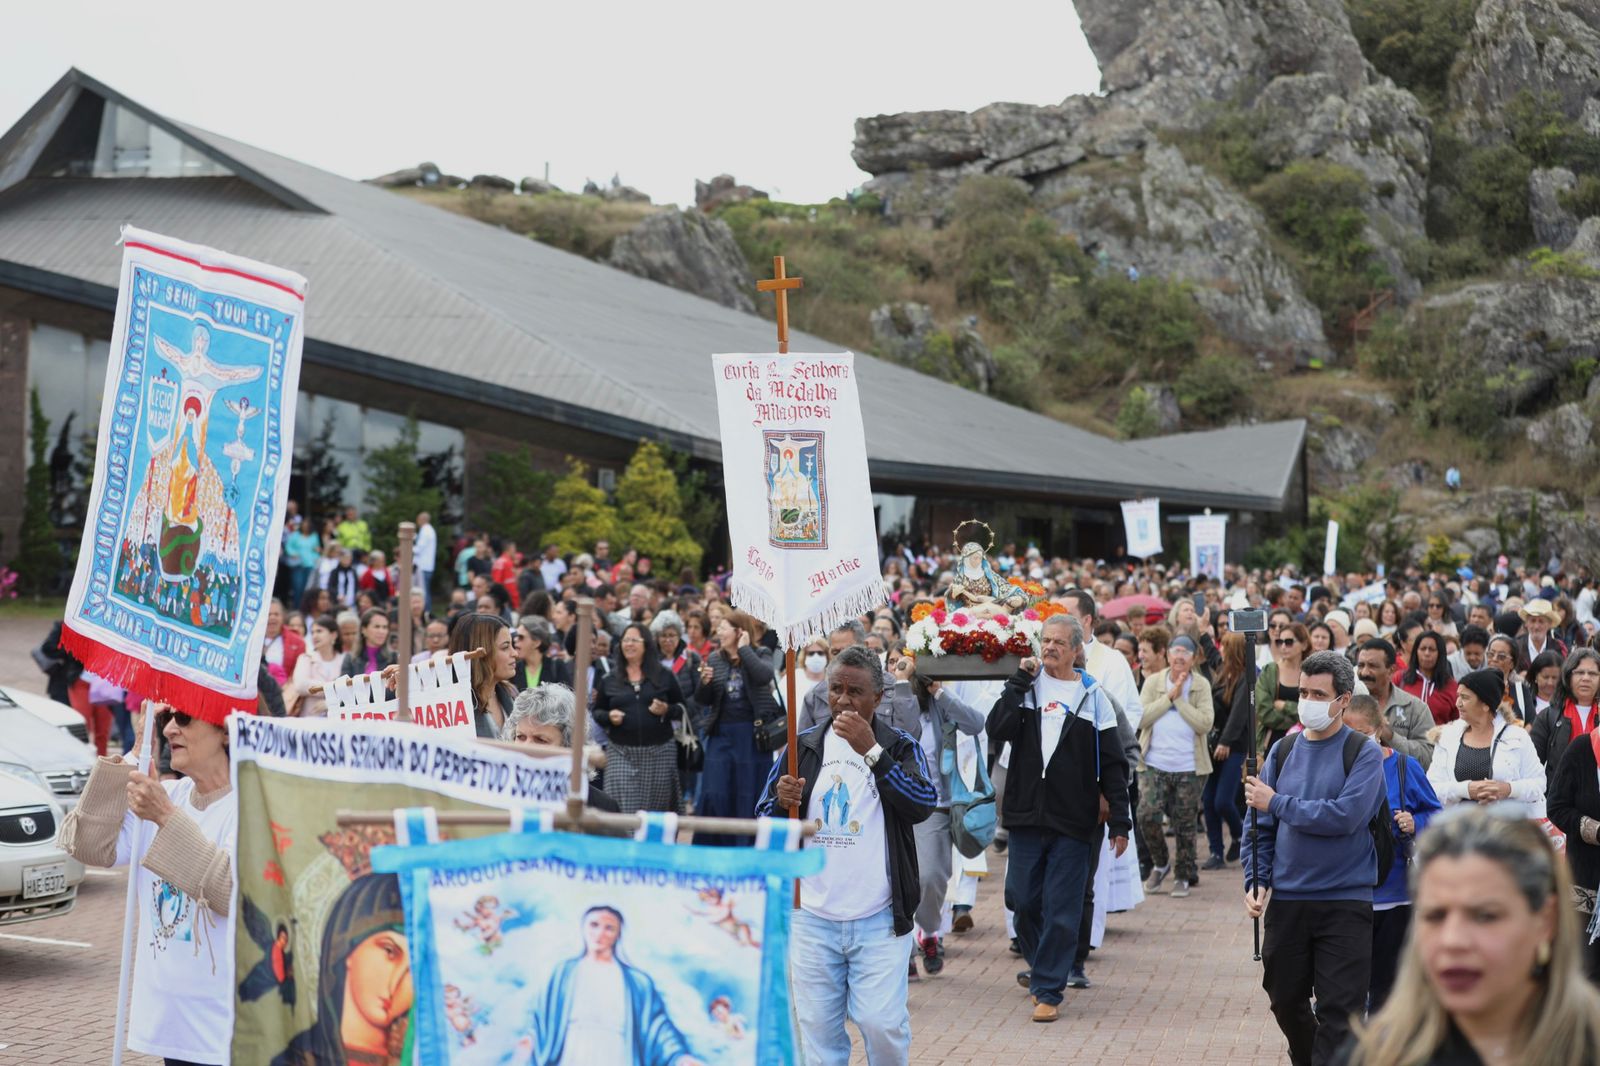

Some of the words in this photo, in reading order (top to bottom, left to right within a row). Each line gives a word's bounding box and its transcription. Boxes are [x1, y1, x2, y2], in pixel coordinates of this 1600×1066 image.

[254, 311, 271, 332] ET
[790, 360, 849, 381] Senhora
[746, 382, 762, 401] da
[768, 380, 837, 403] Medalha
[119, 392, 136, 415] ET
[752, 402, 831, 427] Milagrosa
[112, 423, 129, 447] TE
[747, 545, 775, 582] Legio
[301, 729, 345, 767] NOSSA
[410, 741, 429, 774] DO
